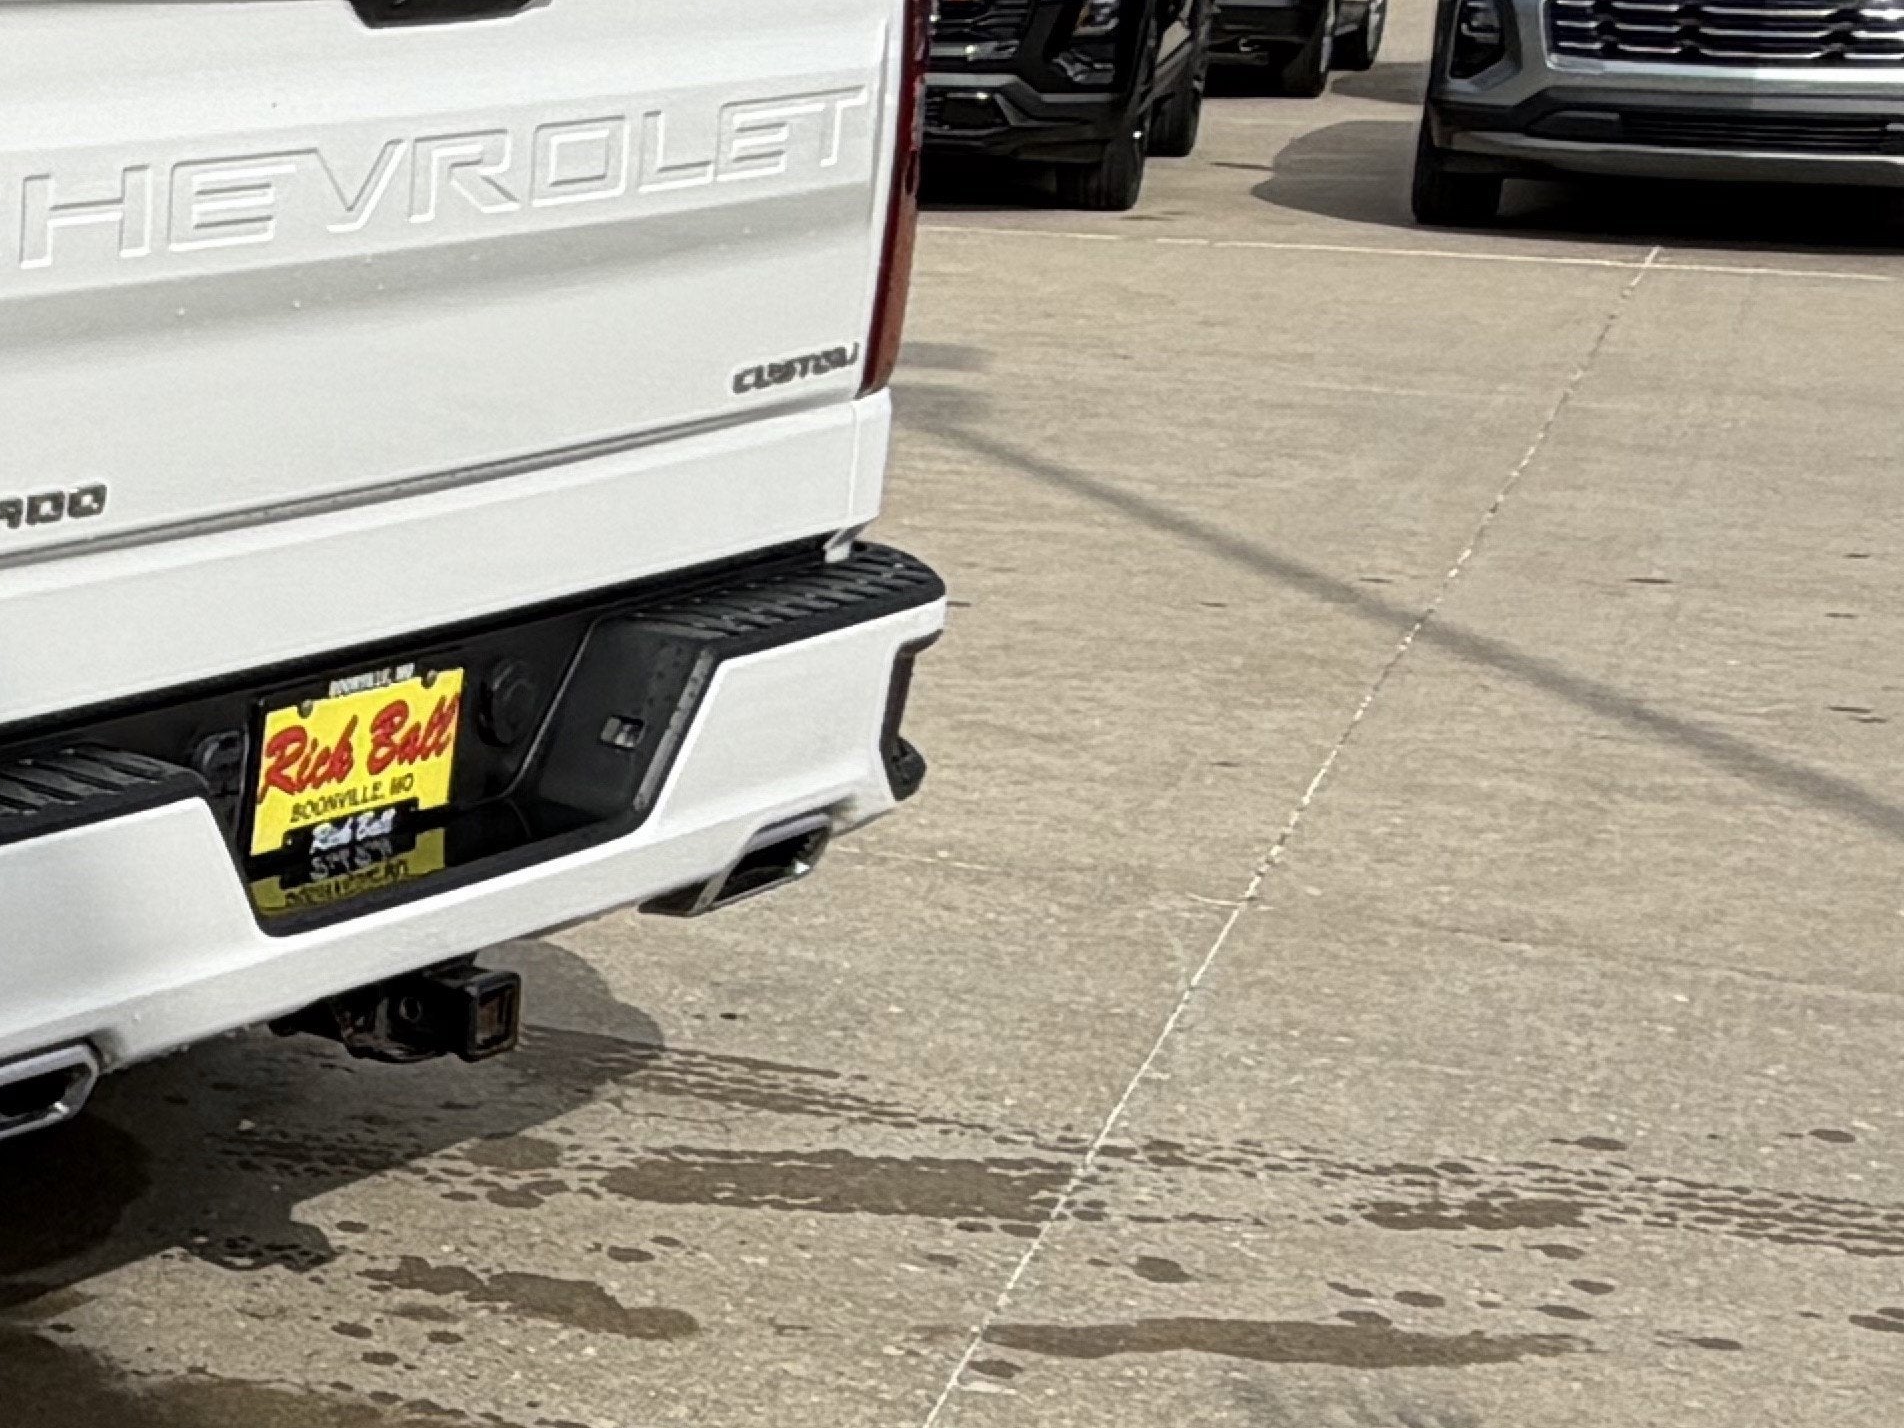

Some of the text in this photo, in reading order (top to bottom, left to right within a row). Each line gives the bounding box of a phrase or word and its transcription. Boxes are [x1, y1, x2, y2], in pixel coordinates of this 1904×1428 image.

[733, 341, 859, 394] CUSTOM
[256, 691, 460, 804] Rick Ball
[390, 772, 414, 795] MO
